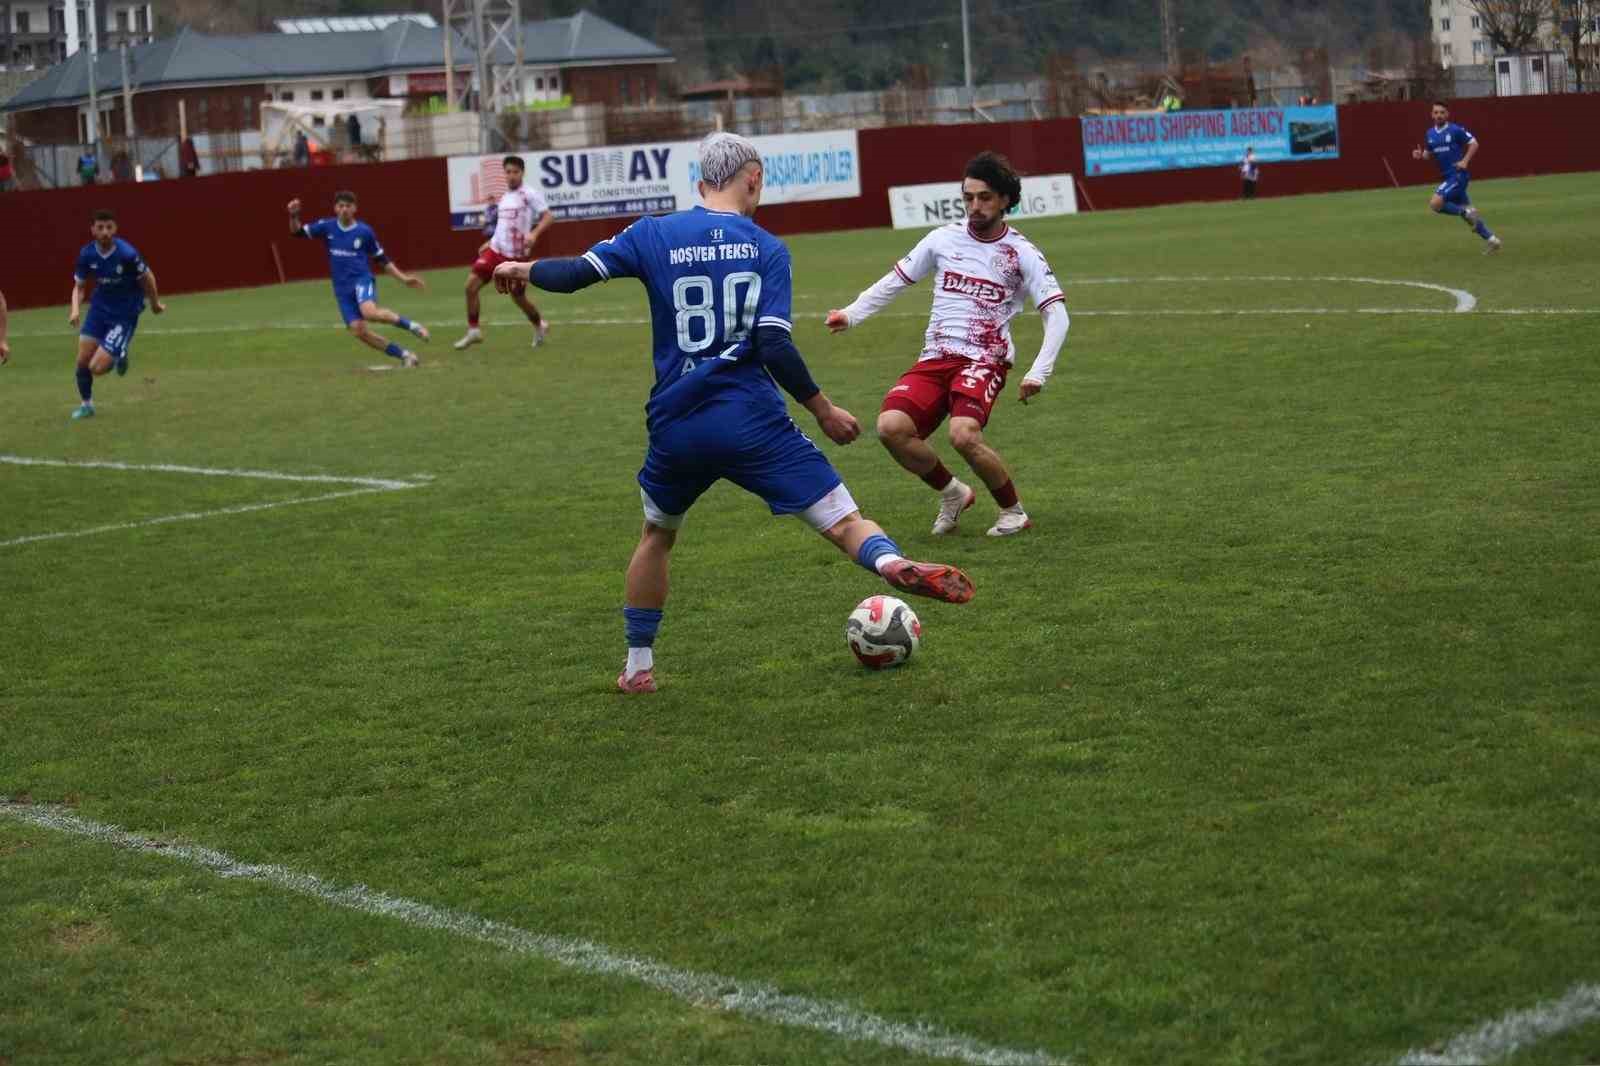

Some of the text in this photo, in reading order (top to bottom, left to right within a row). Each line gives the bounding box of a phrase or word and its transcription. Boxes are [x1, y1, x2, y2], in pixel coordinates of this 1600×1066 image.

[1085, 110, 1284, 146] GRANECO SHIPPING AGENCY
[540, 148, 671, 188] SUMAY
[923, 199, 965, 222] NES
[672, 271, 762, 353] 80
